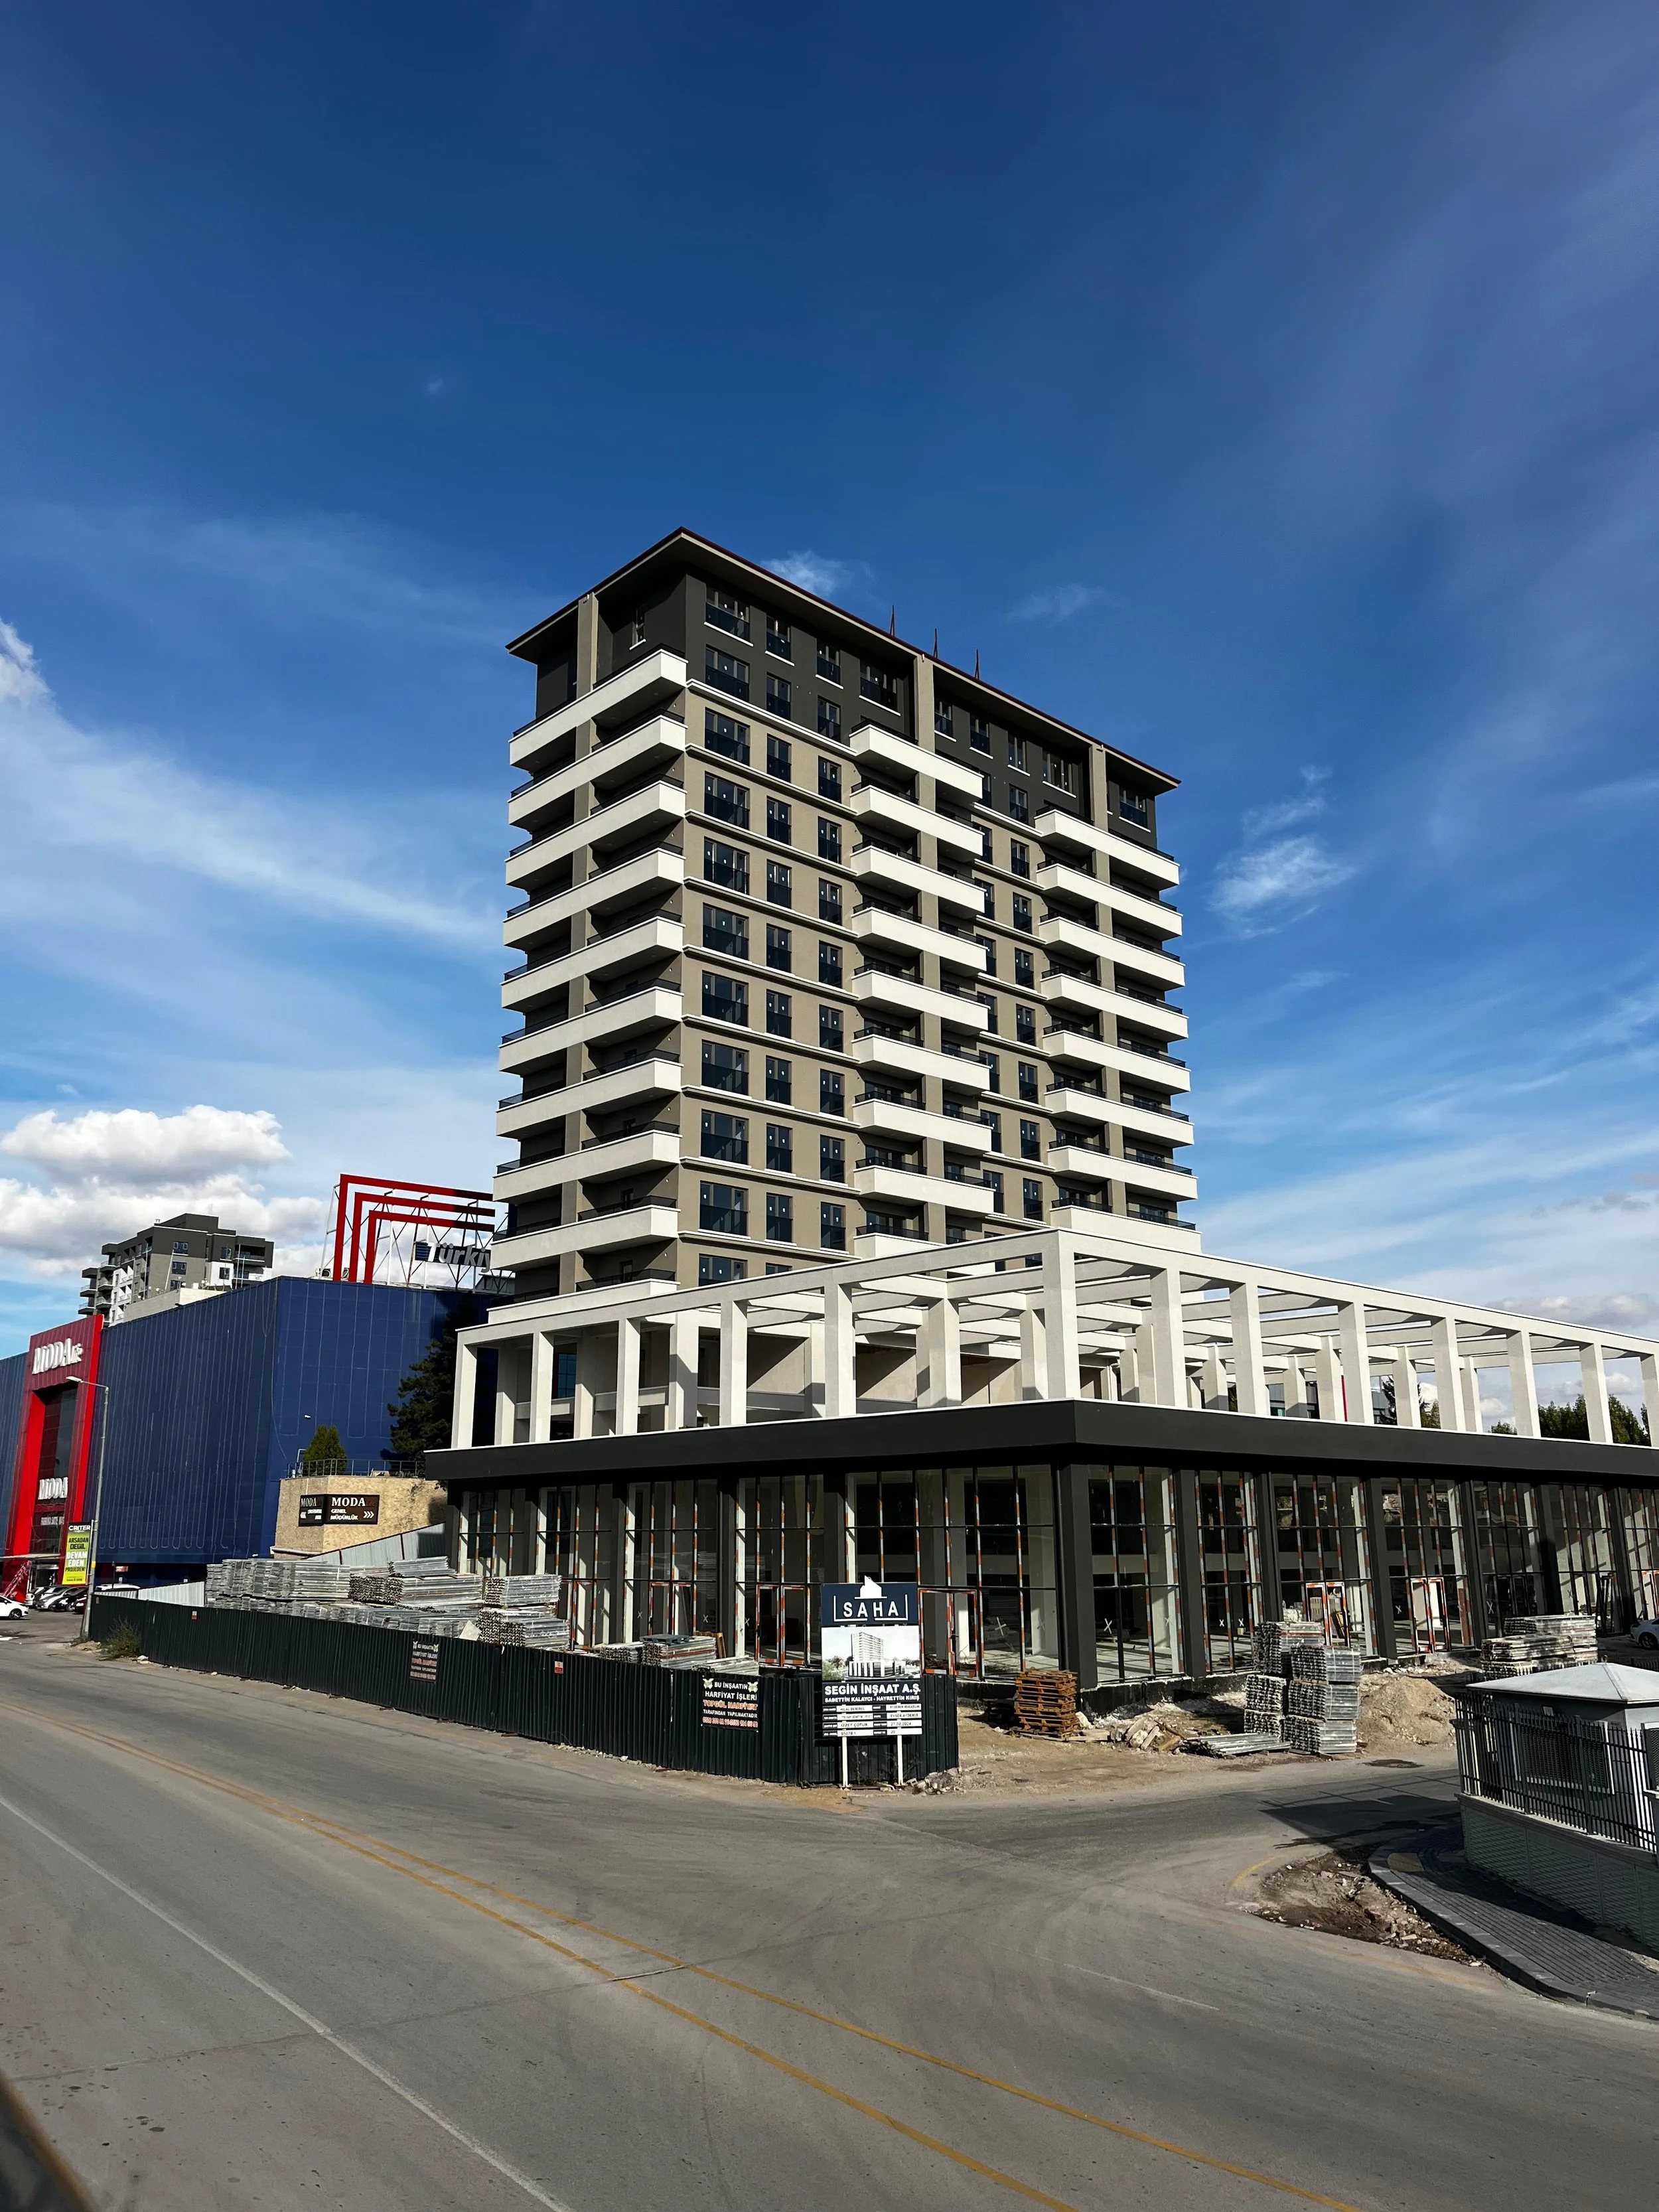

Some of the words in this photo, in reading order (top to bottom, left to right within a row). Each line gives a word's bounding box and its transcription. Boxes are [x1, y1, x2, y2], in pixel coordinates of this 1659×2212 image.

[843, 1601, 899, 1617] SAHA
[723, 1681, 748, 1690] İNŞAATIN
[825, 1684, 858, 1695] SEGİN
[861, 1683, 899, 1696] İNŞAAT
[902, 1683, 921, 1694] A.Ş.
[705, 1690, 735, 1699] HARFİYAT
[737, 1692, 757, 1701] İŞLERİ
